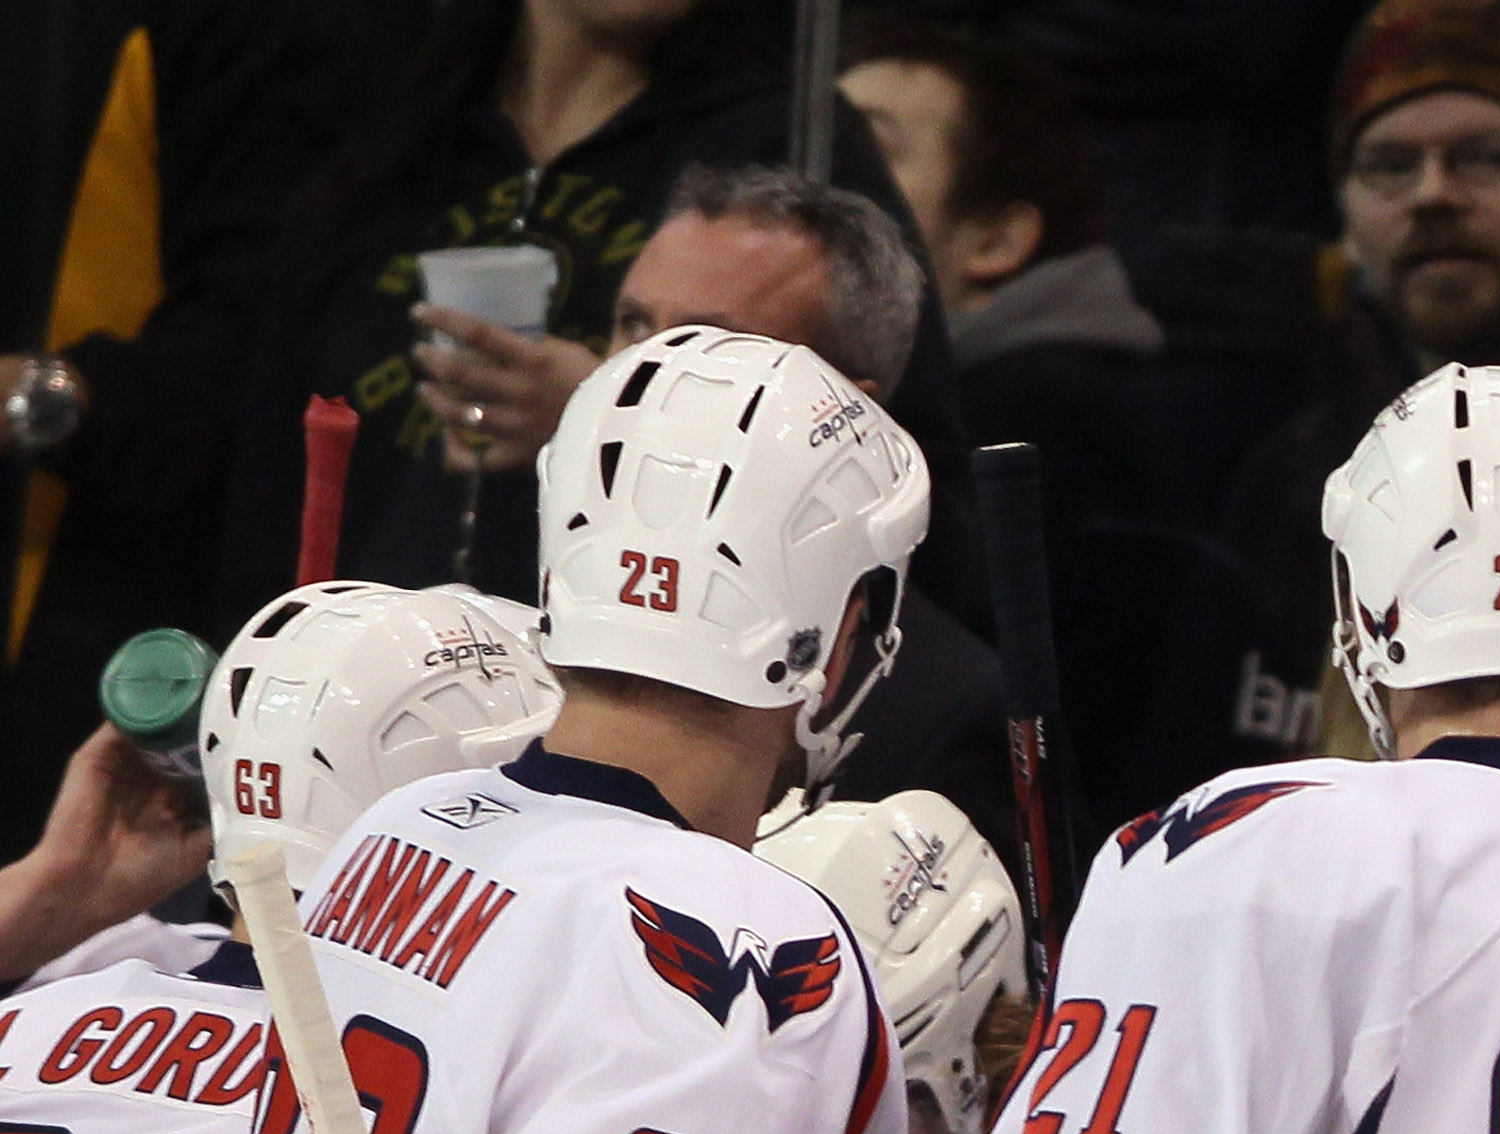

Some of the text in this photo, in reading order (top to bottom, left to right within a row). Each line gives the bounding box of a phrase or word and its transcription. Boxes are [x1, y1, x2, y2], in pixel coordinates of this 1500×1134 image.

[619, 549, 680, 613] 23
[424, 614, 509, 681] capitals
[234, 759, 283, 820] 63
